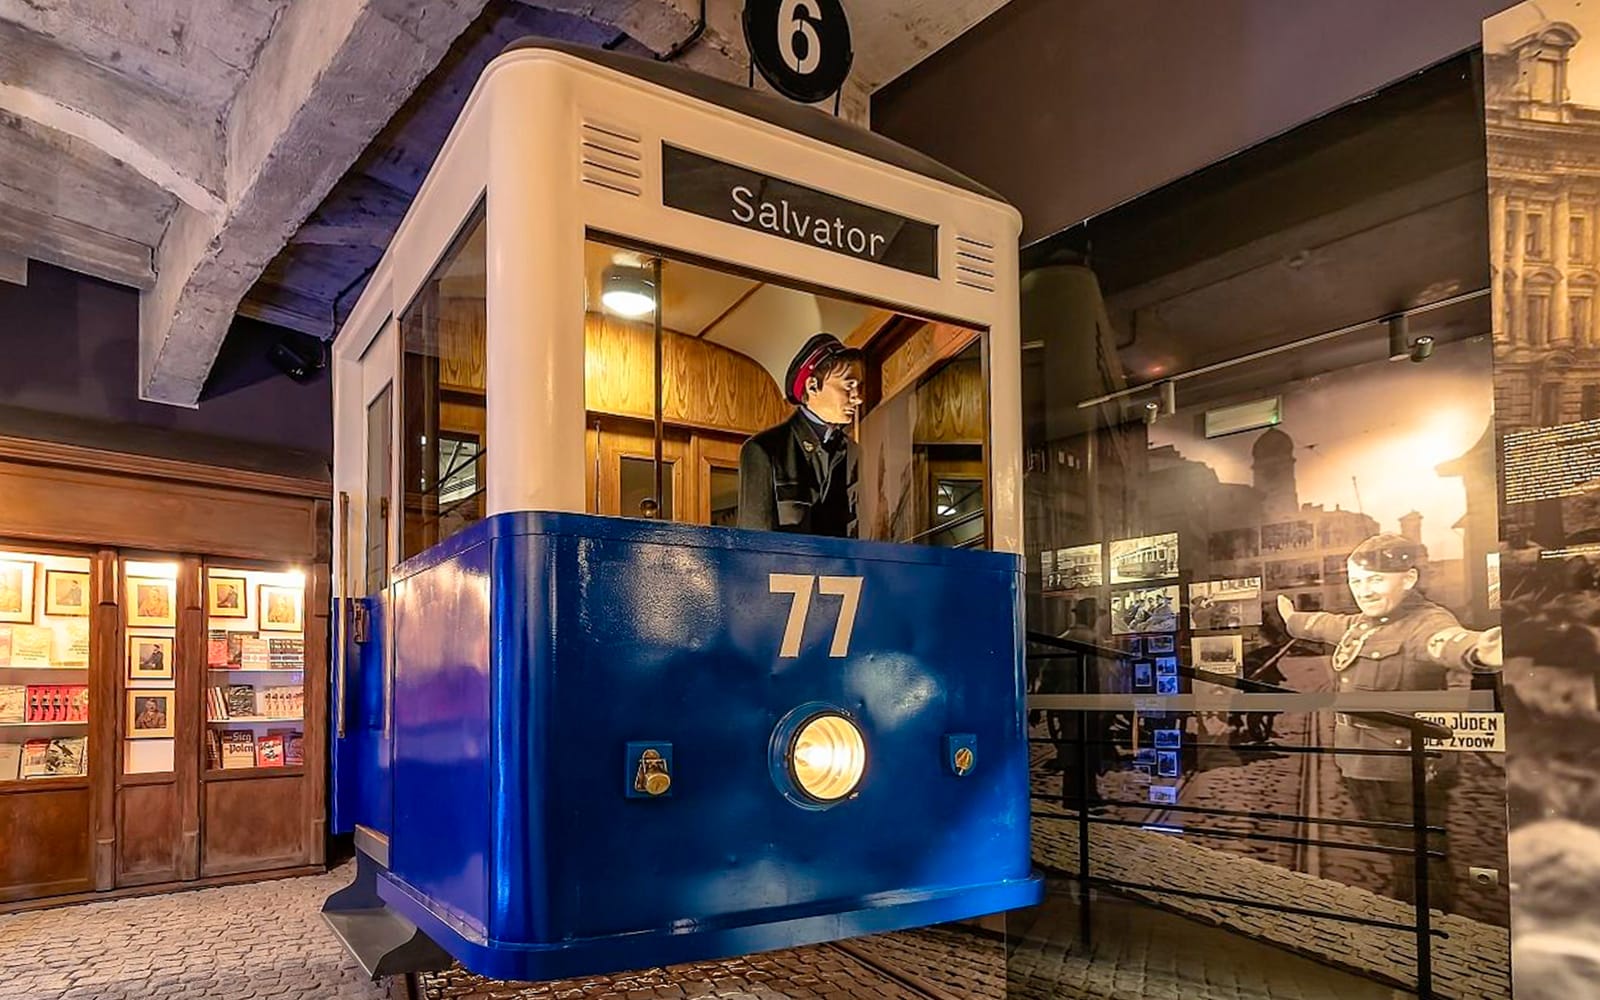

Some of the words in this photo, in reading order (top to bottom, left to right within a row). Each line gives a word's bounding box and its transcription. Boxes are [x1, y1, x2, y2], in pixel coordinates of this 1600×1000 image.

[777, 0, 822, 75] 6
[730, 185, 885, 258] Salvator
[769, 573, 864, 658] 77
[1450, 716, 1497, 731] JUDEN
